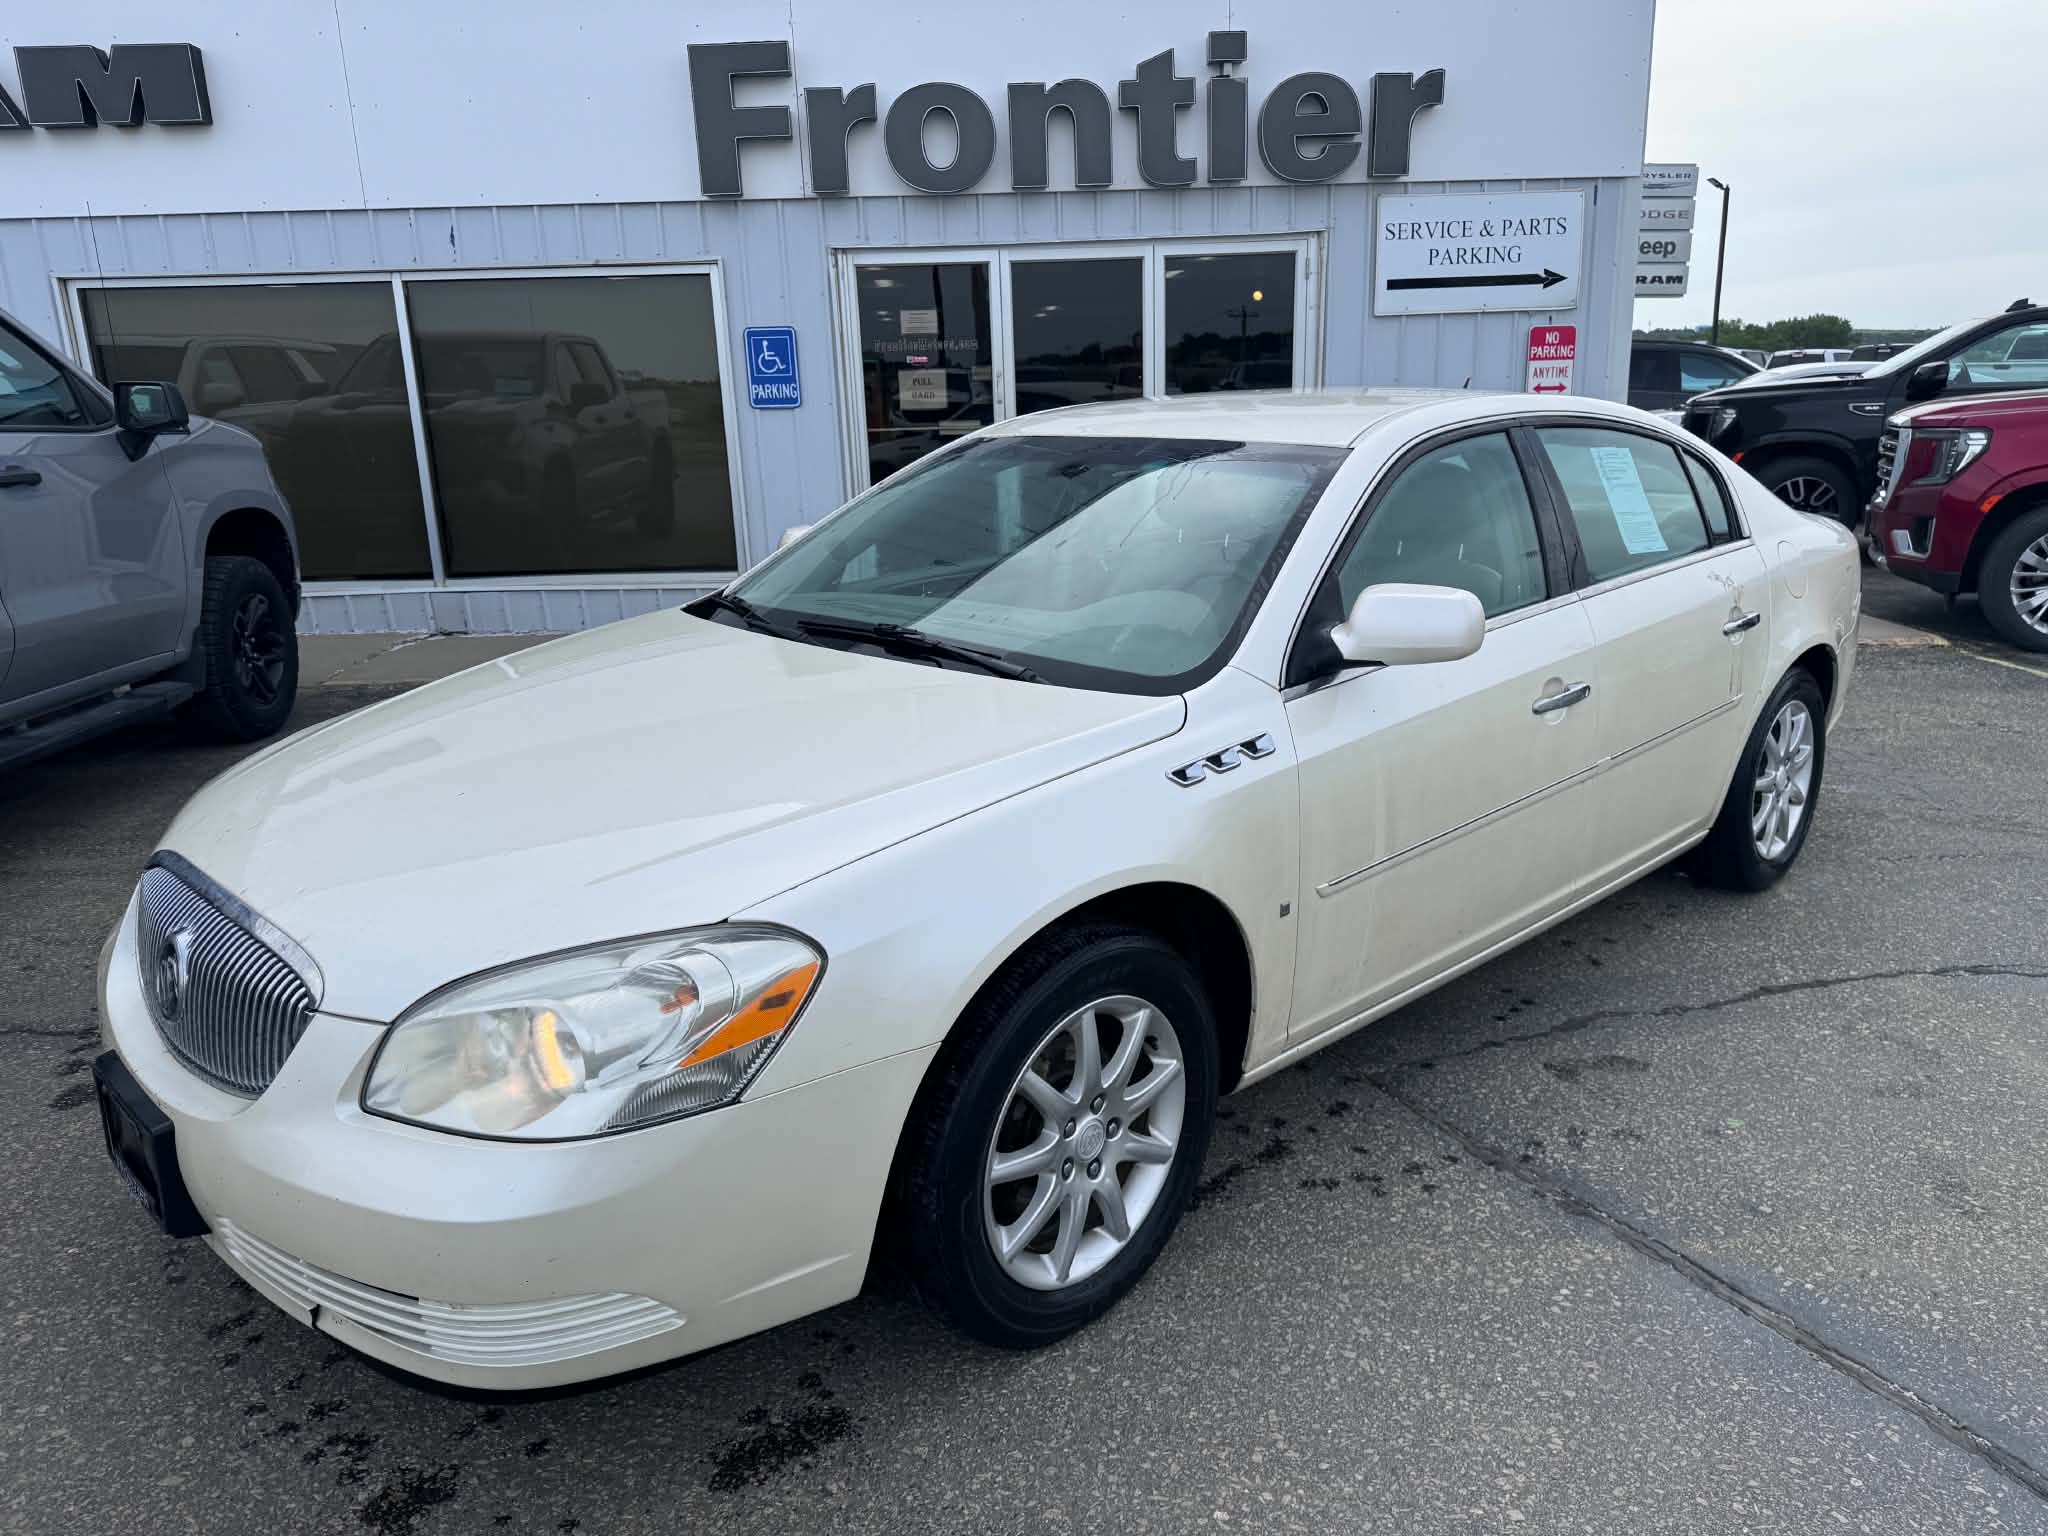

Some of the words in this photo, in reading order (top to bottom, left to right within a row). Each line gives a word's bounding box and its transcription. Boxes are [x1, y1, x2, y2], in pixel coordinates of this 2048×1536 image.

[687, 30, 1446, 197] Frontier
[1385, 220, 1473, 241] SERVICE
[1479, 219, 1495, 237] &
[1502, 217, 1567, 237] PARTS
[1428, 245, 1522, 266] PARKING
[1635, 275, 1684, 285] RAM
[1545, 331, 1559, 344] NO
[1530, 344, 1574, 358] PARKING
[1533, 366, 1568, 379] ANYTIME
[752, 383, 798, 399] PARKING
